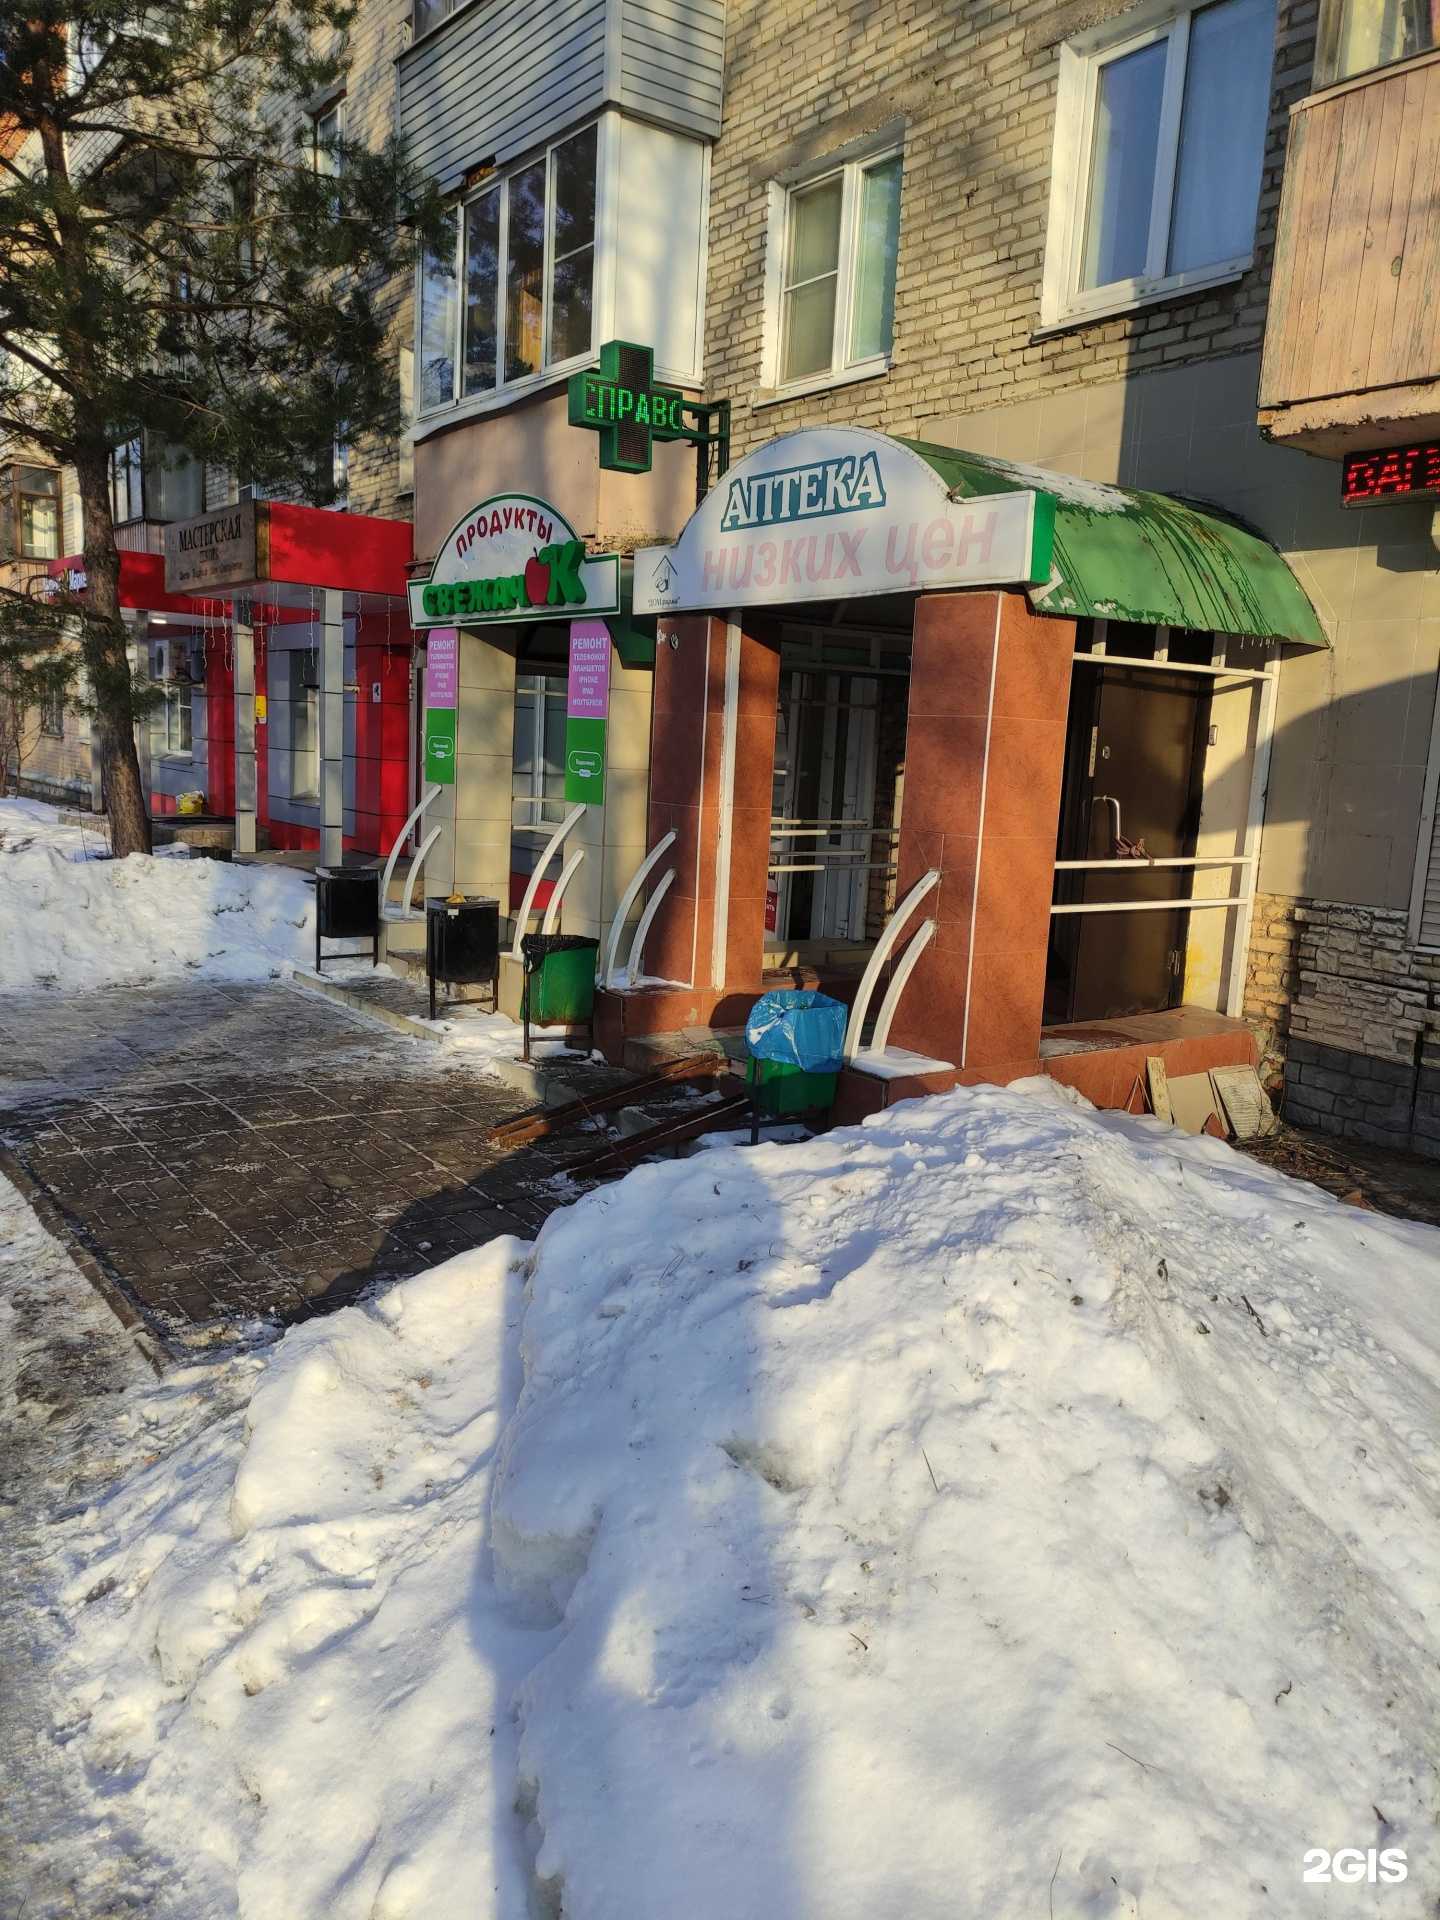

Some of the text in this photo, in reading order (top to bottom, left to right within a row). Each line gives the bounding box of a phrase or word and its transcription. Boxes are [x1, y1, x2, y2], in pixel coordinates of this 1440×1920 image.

[720, 451, 887, 532] АПТЕКА
[178, 513, 242, 553] МАСТЕРСКАЯ
[455, 507, 553, 558] ПРОДУКТЫ
[571, 638, 608, 650] РЕМОНТ
